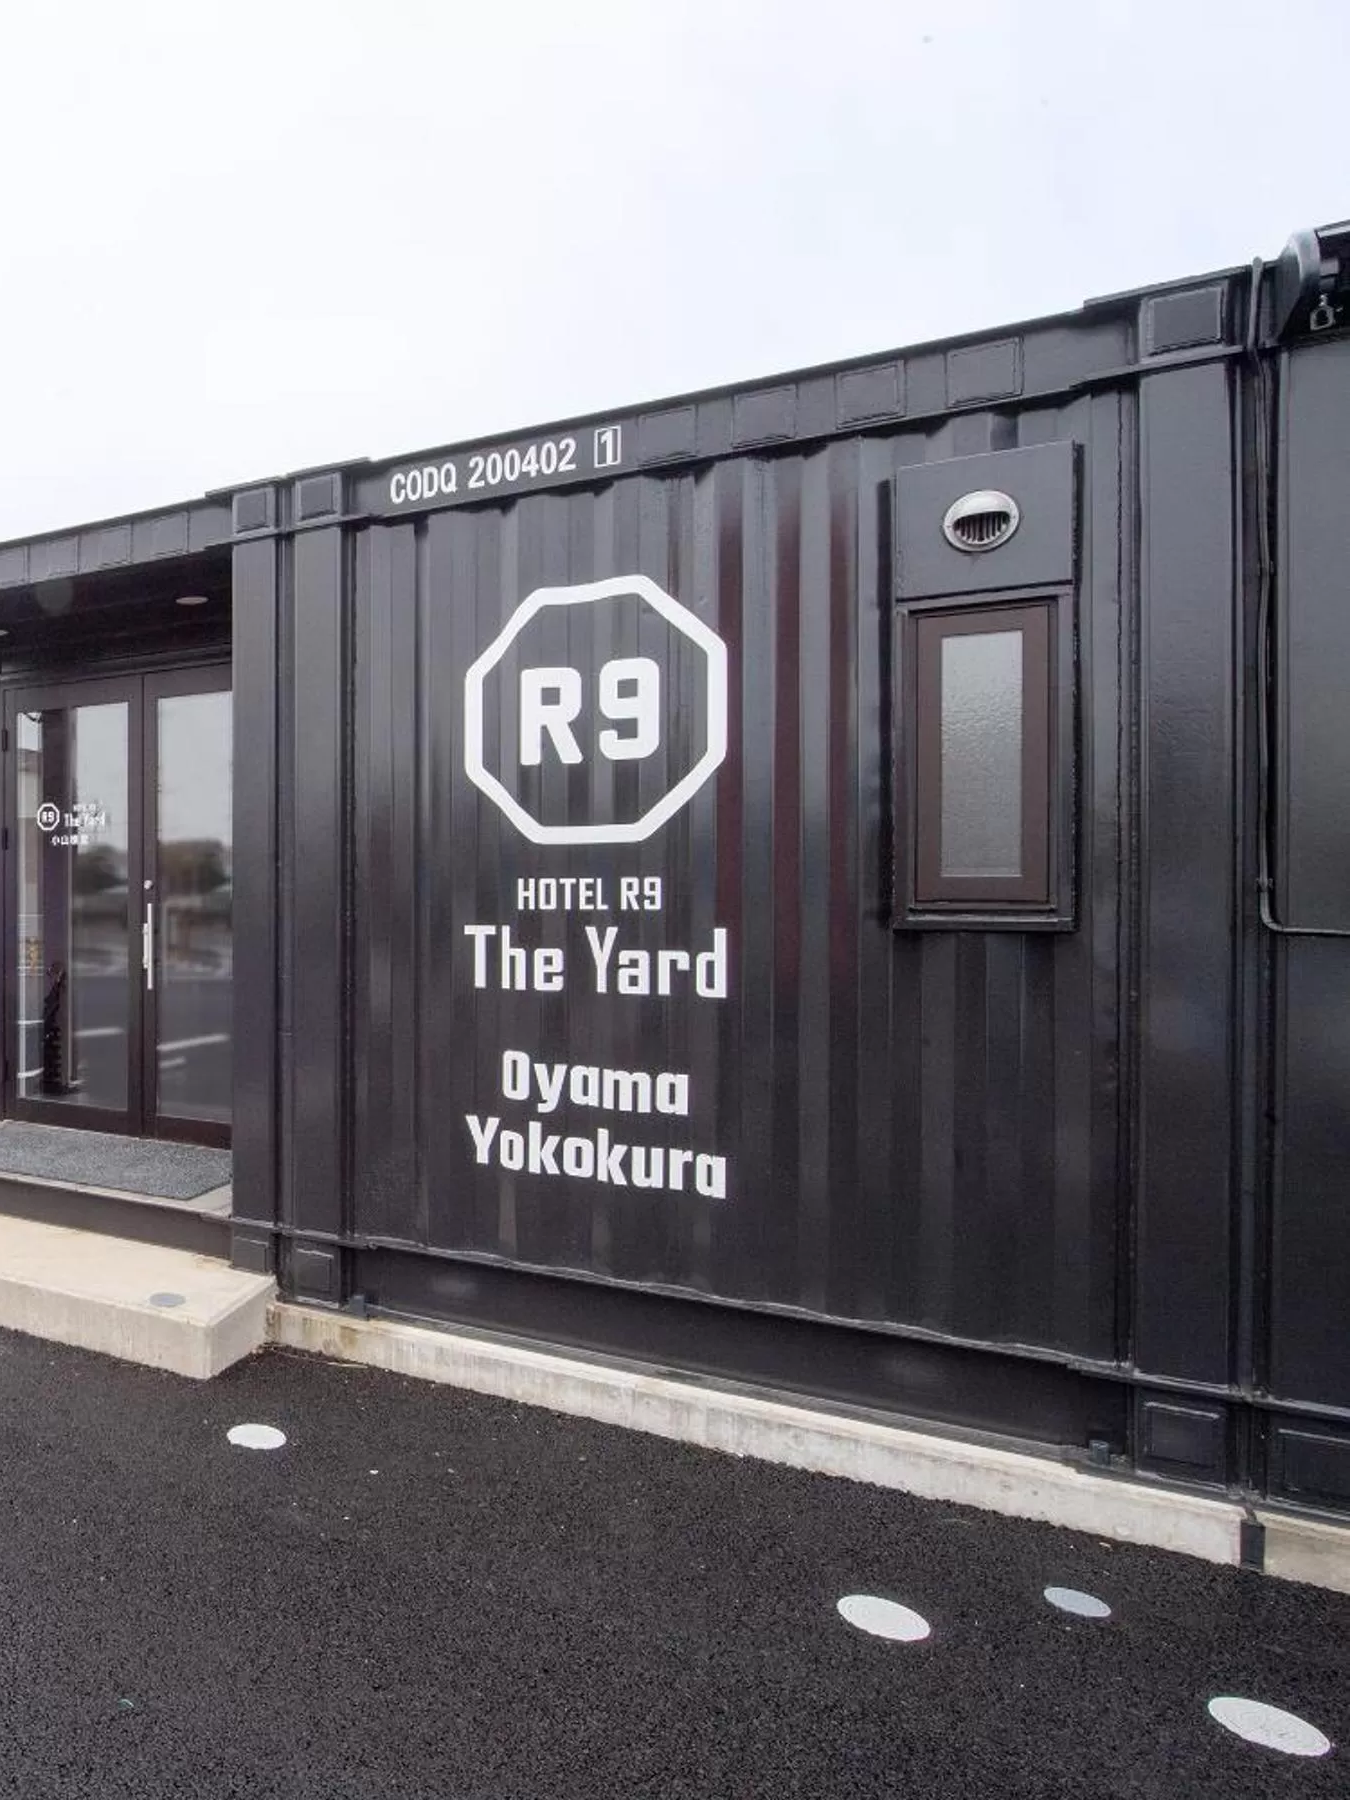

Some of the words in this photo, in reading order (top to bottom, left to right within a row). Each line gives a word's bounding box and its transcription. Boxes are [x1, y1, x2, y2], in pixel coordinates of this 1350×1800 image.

[390, 462, 458, 504] CODQ
[467, 437, 577, 490] 200402
[519, 656, 660, 766] R9
[517, 877, 609, 911] HOTEL
[620, 876, 662, 911] R9
[464, 924, 564, 991] The
[585, 926, 727, 998] Yard
[502, 1049, 689, 1116] Oyama
[465, 1114, 727, 1199] Yokokura
